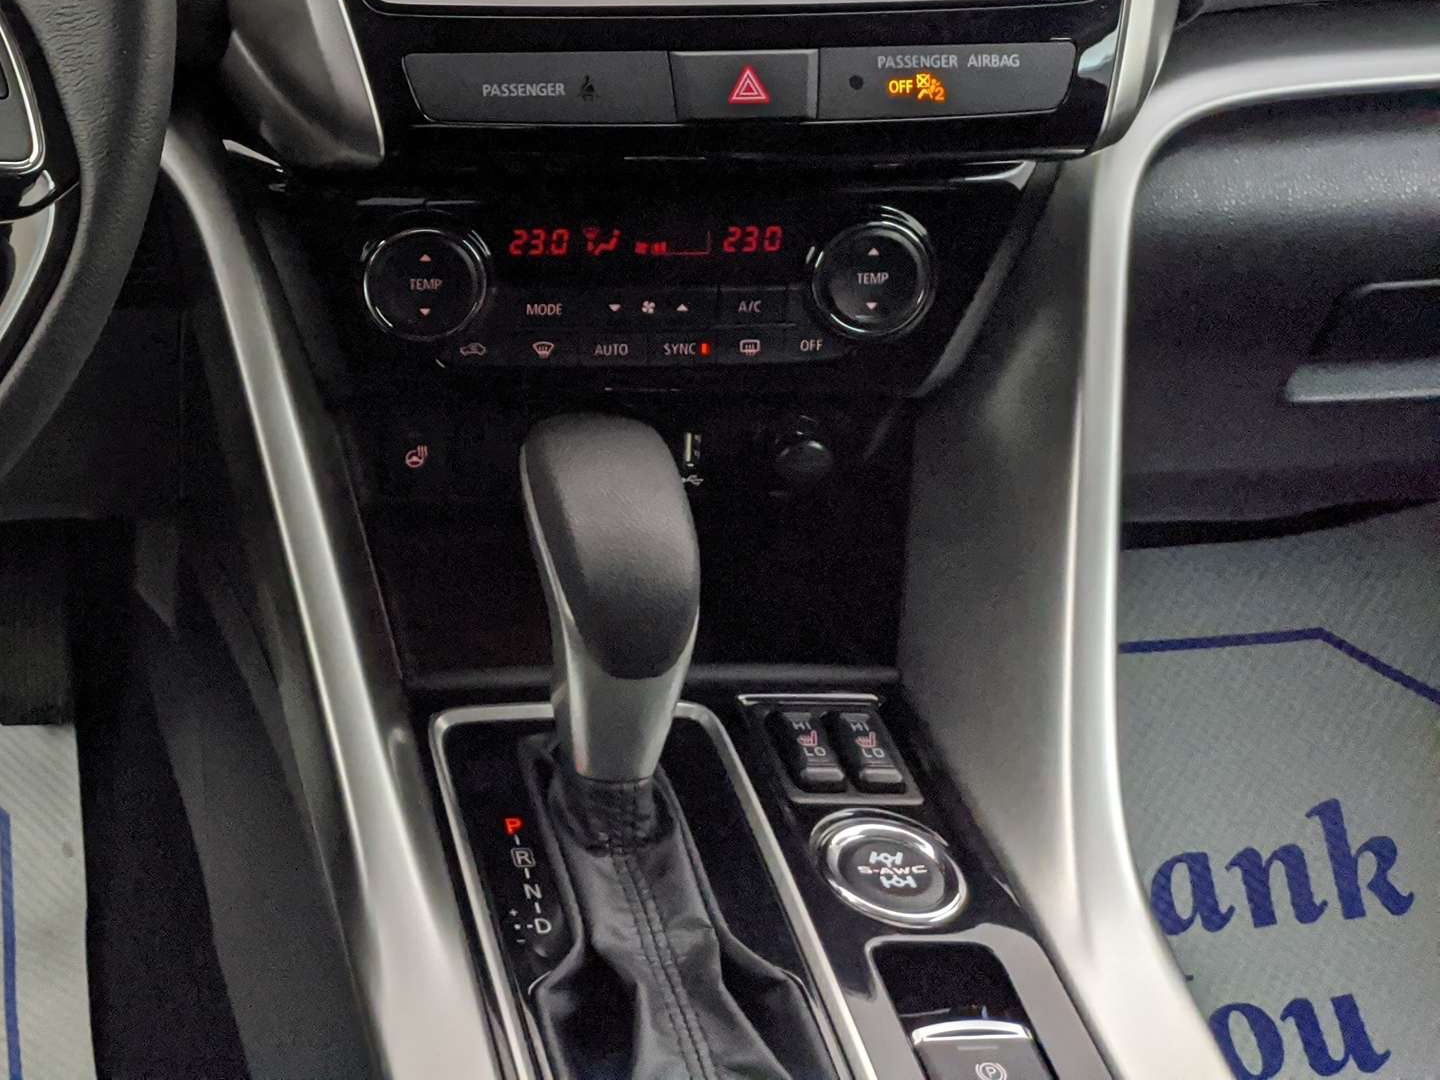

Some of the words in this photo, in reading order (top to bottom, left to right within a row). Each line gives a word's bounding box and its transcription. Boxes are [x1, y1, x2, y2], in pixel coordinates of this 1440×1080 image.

[877, 54, 959, 69] PASSENGER
[967, 53, 1020, 68] AIRBAG
[482, 83, 566, 97] PASSENGER
[888, 79, 913, 94] OFF
[409, 278, 443, 291] TEMP
[856, 272, 889, 285] TEMP
[526, 303, 564, 316] MODE
[738, 299, 762, 313] A/C
[593, 343, 629, 357] AUTO
[663, 342, 697, 356] SYNC
[800, 339, 824, 352] OFF
[803, 746, 827, 757] LO
[862, 747, 885, 758] LO
[504, 818, 523, 834] P
[856, 864, 929, 875] S-AWC
[1150, 797, 1415, 937] ank
[523, 883, 543, 900] N
[534, 918, 552, 934] D
[1185, 974, 1393, 1080] ou
